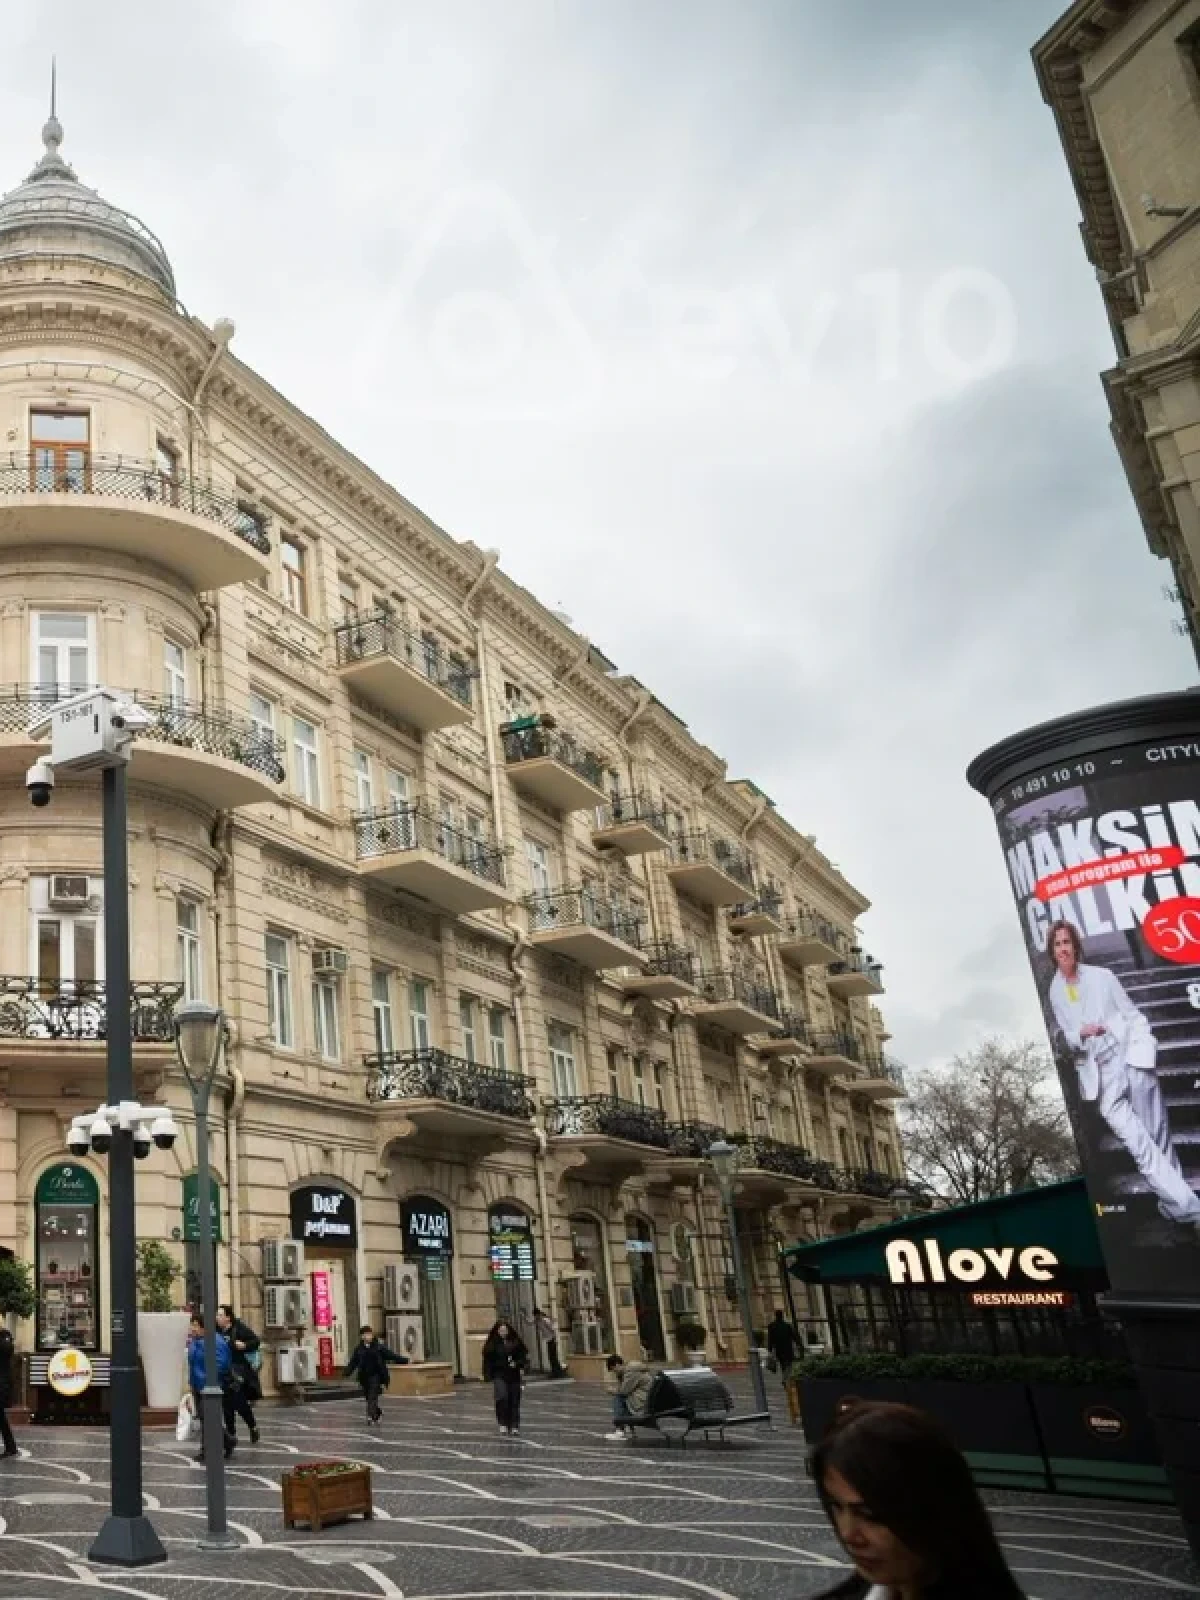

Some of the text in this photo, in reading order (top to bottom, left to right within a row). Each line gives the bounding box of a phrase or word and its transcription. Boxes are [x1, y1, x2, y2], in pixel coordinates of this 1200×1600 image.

[1052, 767, 1071, 783] 10
[1074, 761, 1096, 778] 10
[885, 1238, 1059, 1284] Alove
[972, 1292, 1065, 1306] RESTAURANT
